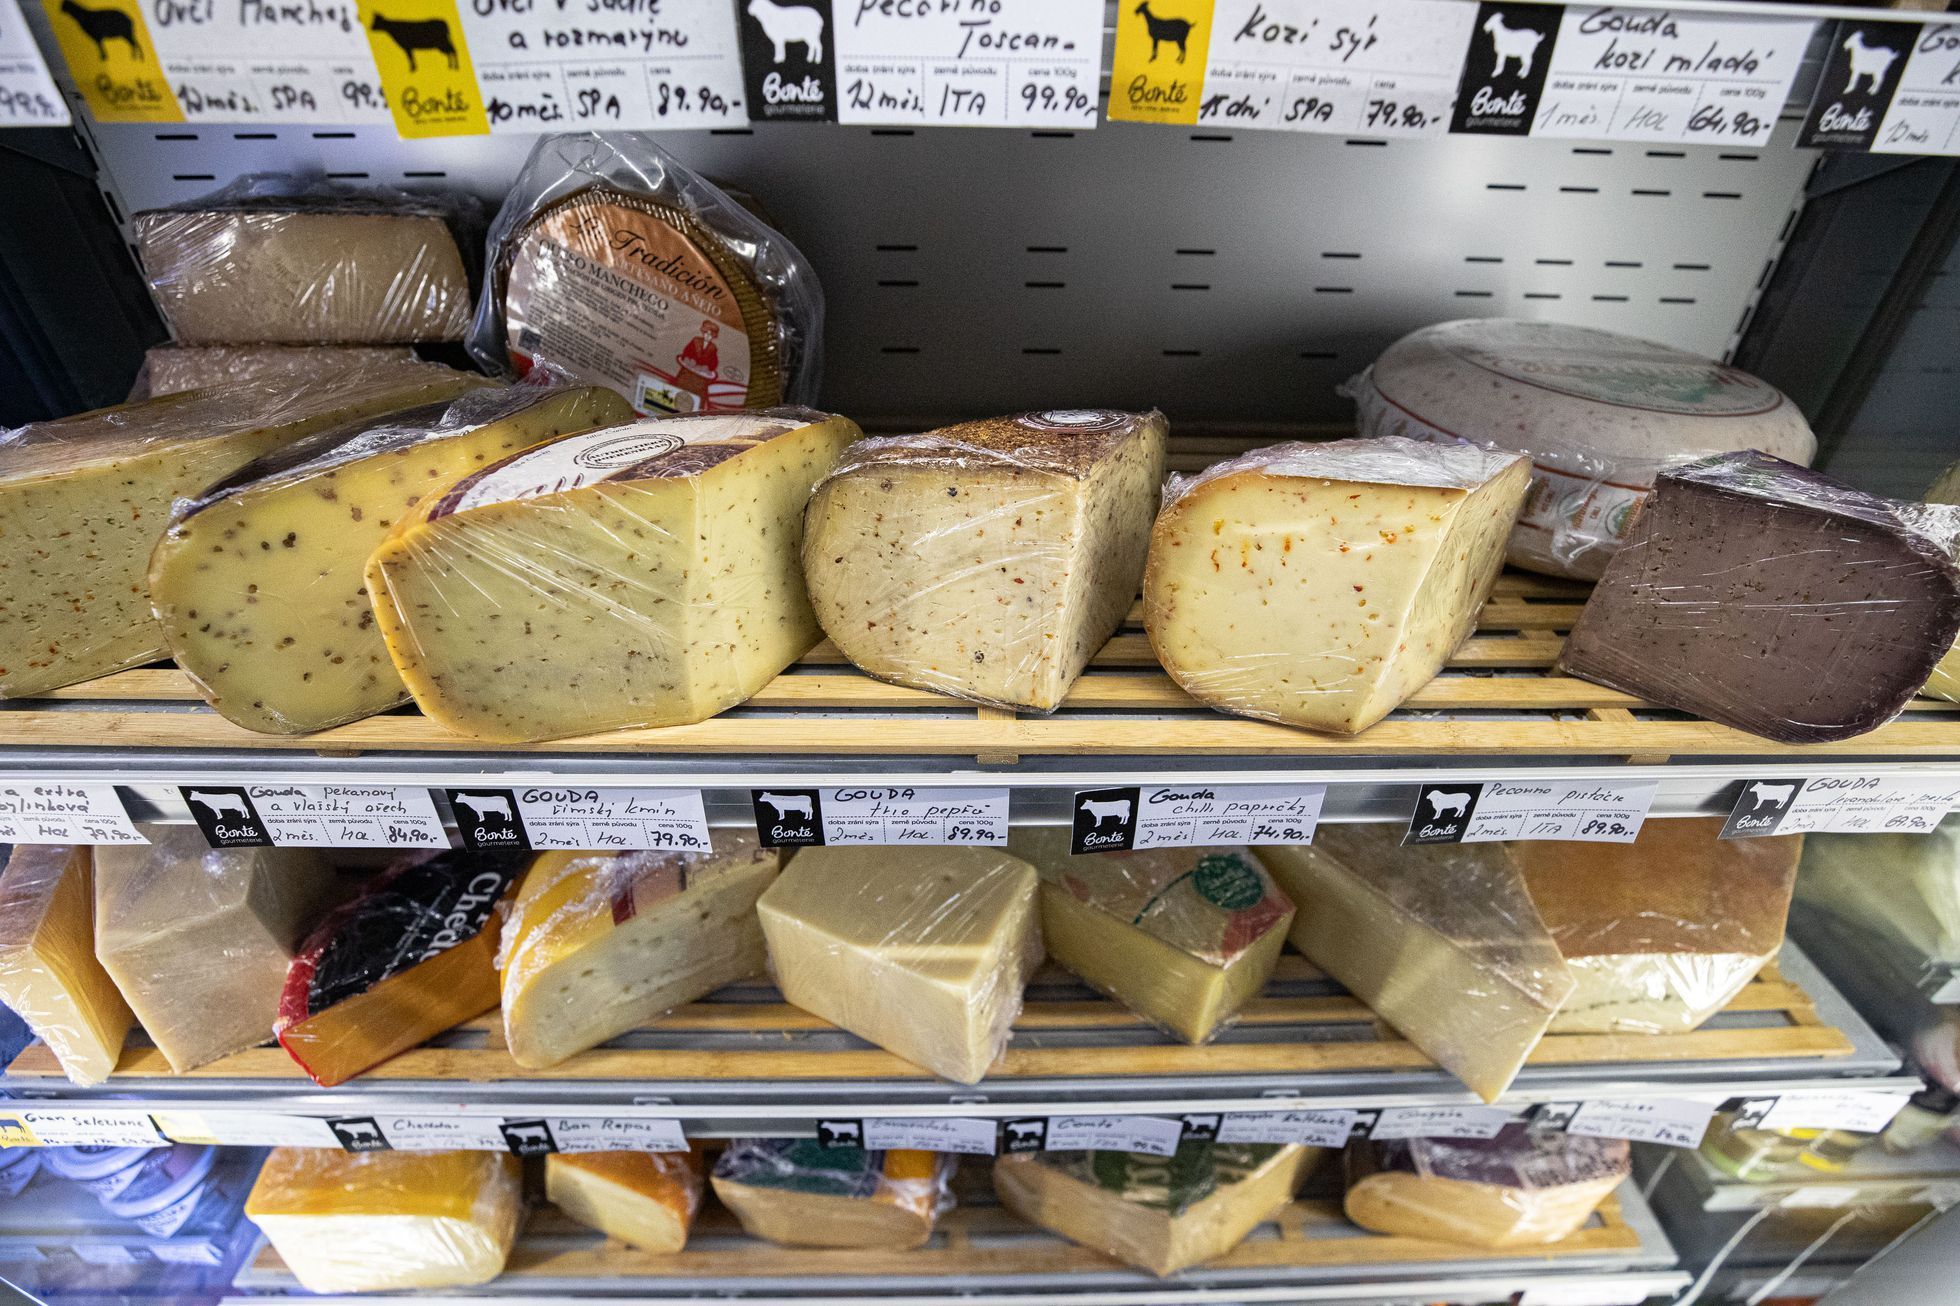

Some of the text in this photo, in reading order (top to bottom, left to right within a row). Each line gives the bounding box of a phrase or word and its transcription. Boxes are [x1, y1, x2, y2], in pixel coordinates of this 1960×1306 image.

[1579, 7, 1679, 39] Gouda
[508, 31, 528, 49] a
[762, 72, 825, 104] Bonté
[1127, 75, 1188, 104] Bonté
[578, 88, 621, 120] SPA
[939, 84, 986, 117] ITA
[1470, 85, 1527, 117] Bonté
[1284, 97, 1334, 123] SPA
[609, 229, 728, 301] Tradición
[590, 263, 670, 311] MANCHEGO
[249, 786, 307, 798] Gouda
[1806, 777, 1881, 792] GOUDA
[522, 789, 599, 803] GOUDA
[835, 788, 915, 802] GOUDA
[1148, 788, 1215, 804] Gouda
[270, 803, 283, 812] a
[911, 818, 938, 826] původu
[1222, 818, 1248, 826] původu
[1613, 812, 1630, 820] 100g
[1736, 814, 1773, 829] Bonté
[215, 824, 258, 839] Bonté
[676, 822, 693, 830] 100g
[1177, 820, 1191, 828] sýra
[1419, 824, 1458, 838] Bonté
[474, 827, 517, 842] Bonté
[771, 825, 814, 839] Bonté
[1084, 832, 1125, 846] Bonté
[418, 871, 503, 963] Ched
